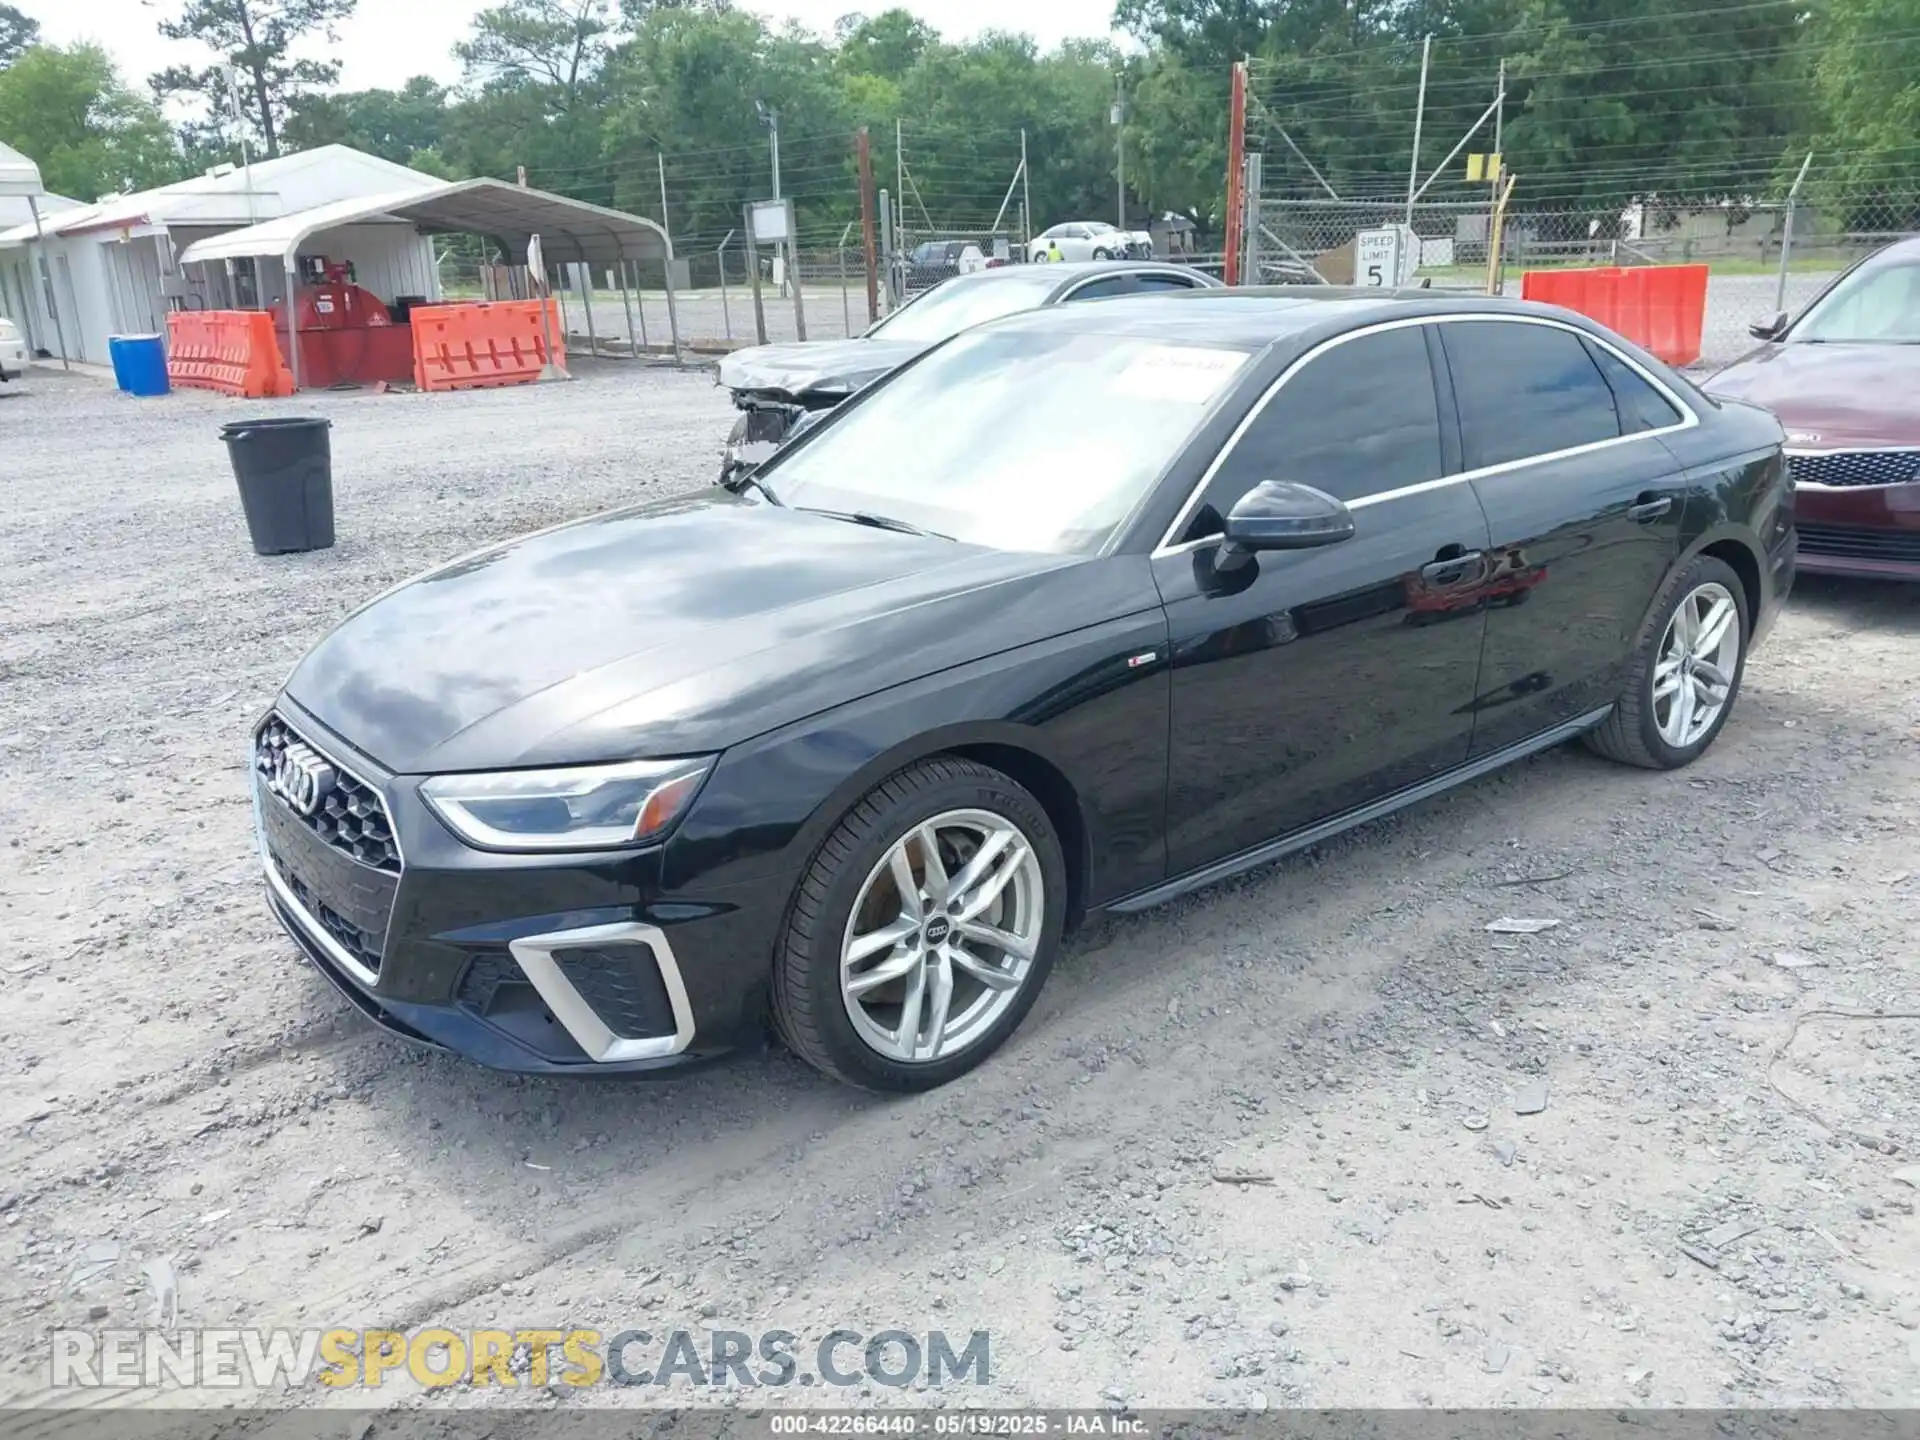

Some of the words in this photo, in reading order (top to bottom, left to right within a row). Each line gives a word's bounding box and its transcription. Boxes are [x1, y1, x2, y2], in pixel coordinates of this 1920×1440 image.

[1360, 236, 1394, 247] SPEED
[1362, 251, 1390, 261] LIMIT
[1368, 265, 1383, 287] 5
